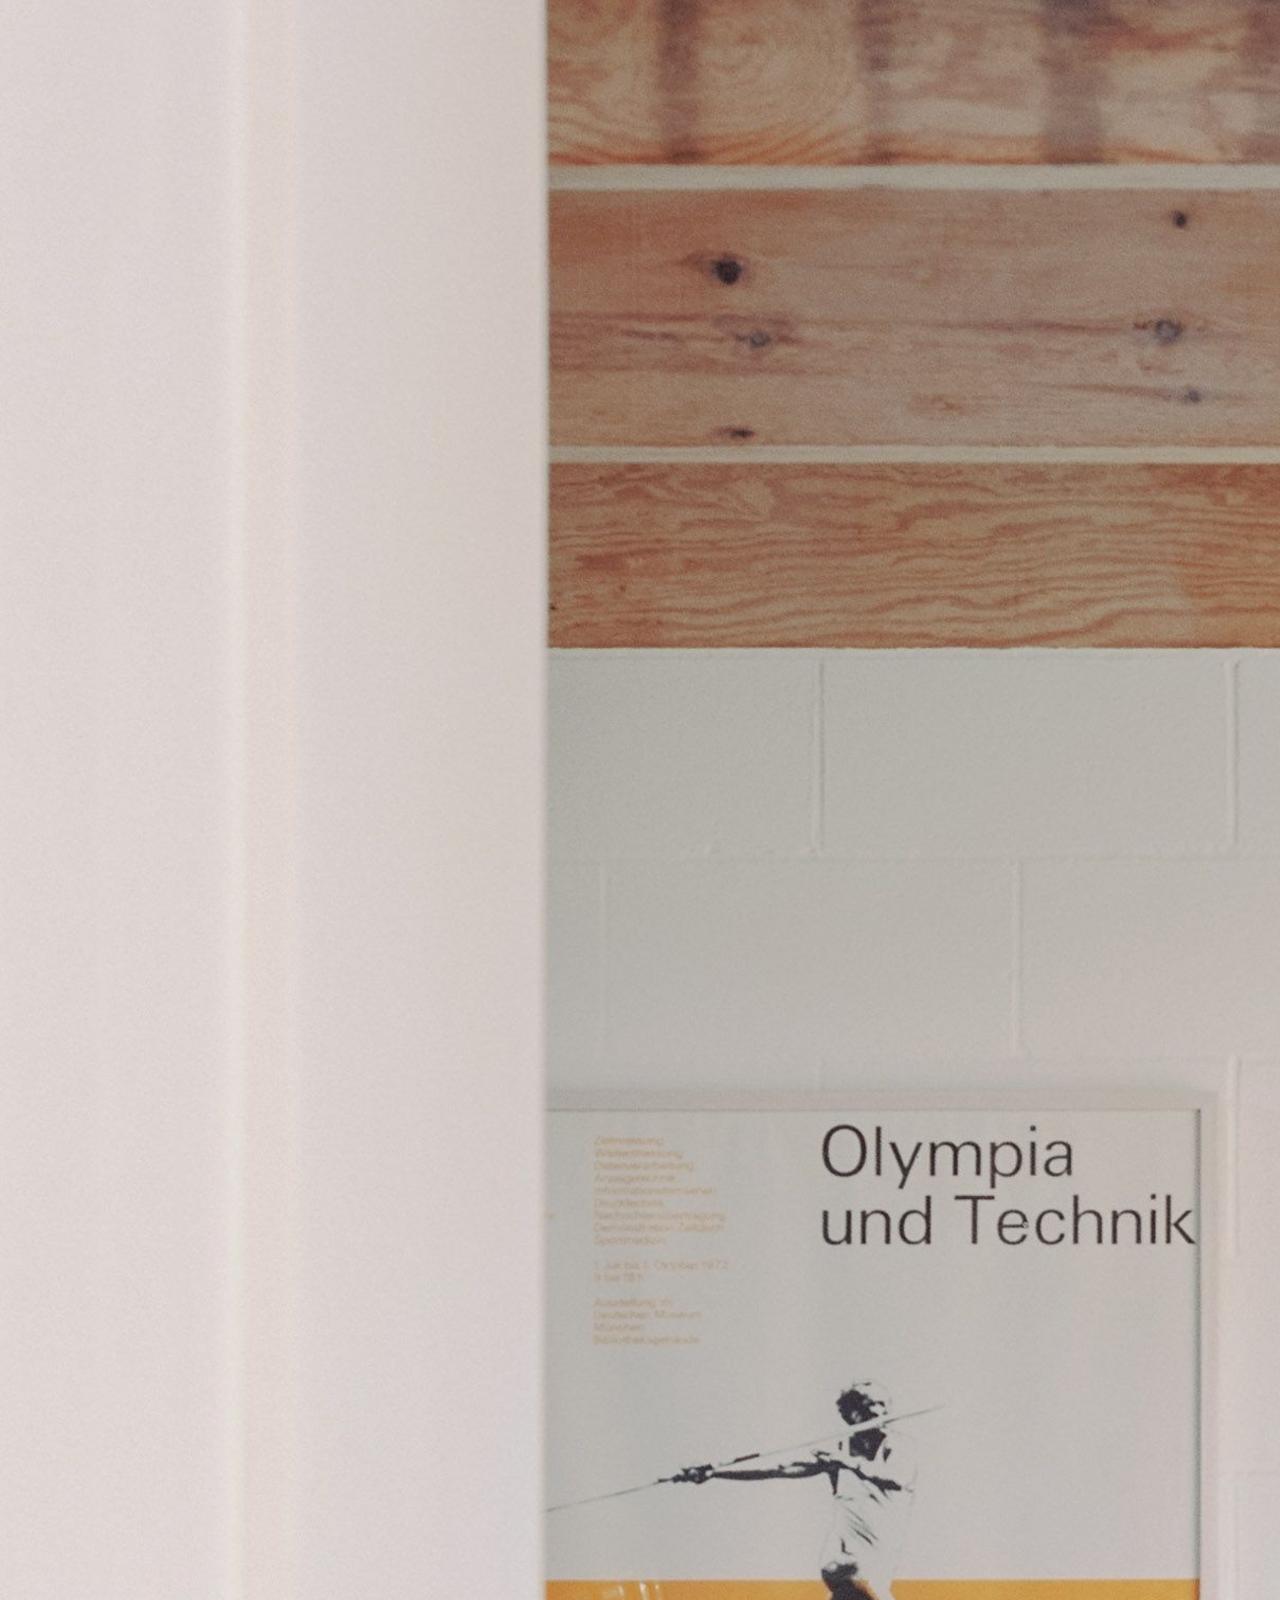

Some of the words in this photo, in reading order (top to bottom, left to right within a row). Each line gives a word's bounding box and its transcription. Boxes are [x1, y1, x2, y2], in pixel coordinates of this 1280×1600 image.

[823, 1125, 1071, 1189] Olympia
[823, 1196, 931, 1245] und
[955, 1194, 1194, 1245] Technik
